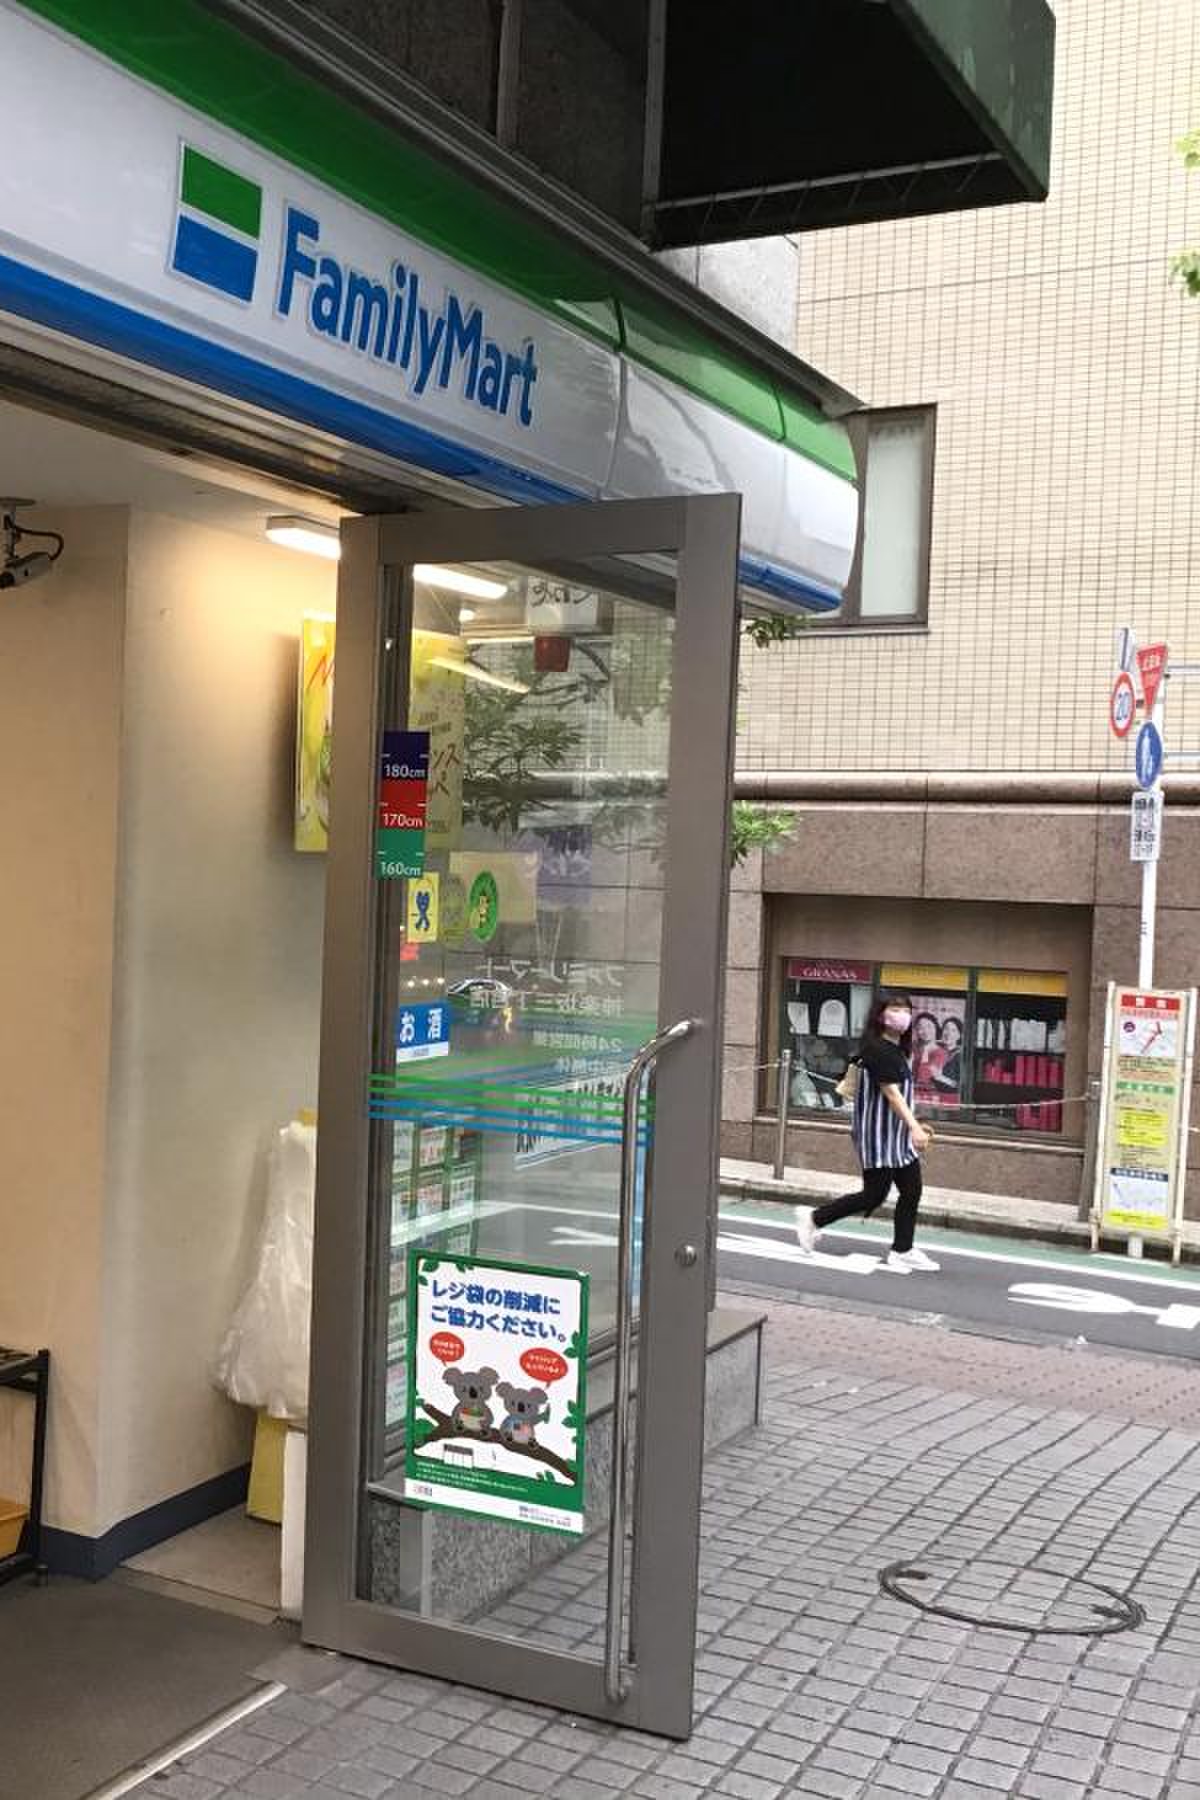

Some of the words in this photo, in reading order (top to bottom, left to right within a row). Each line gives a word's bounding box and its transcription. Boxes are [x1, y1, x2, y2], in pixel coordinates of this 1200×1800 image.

[278, 206, 537, 427] FamilyMart
[384, 763, 426, 779] 180cm
[383, 813, 423, 828] 170cm
[381, 861, 422, 877] 160cm
[398, 1008, 445, 1043] お酒
[431, 1279, 561, 1316] レジ袋の削減に
[430, 1304, 567, 1343] ご協力ください。
